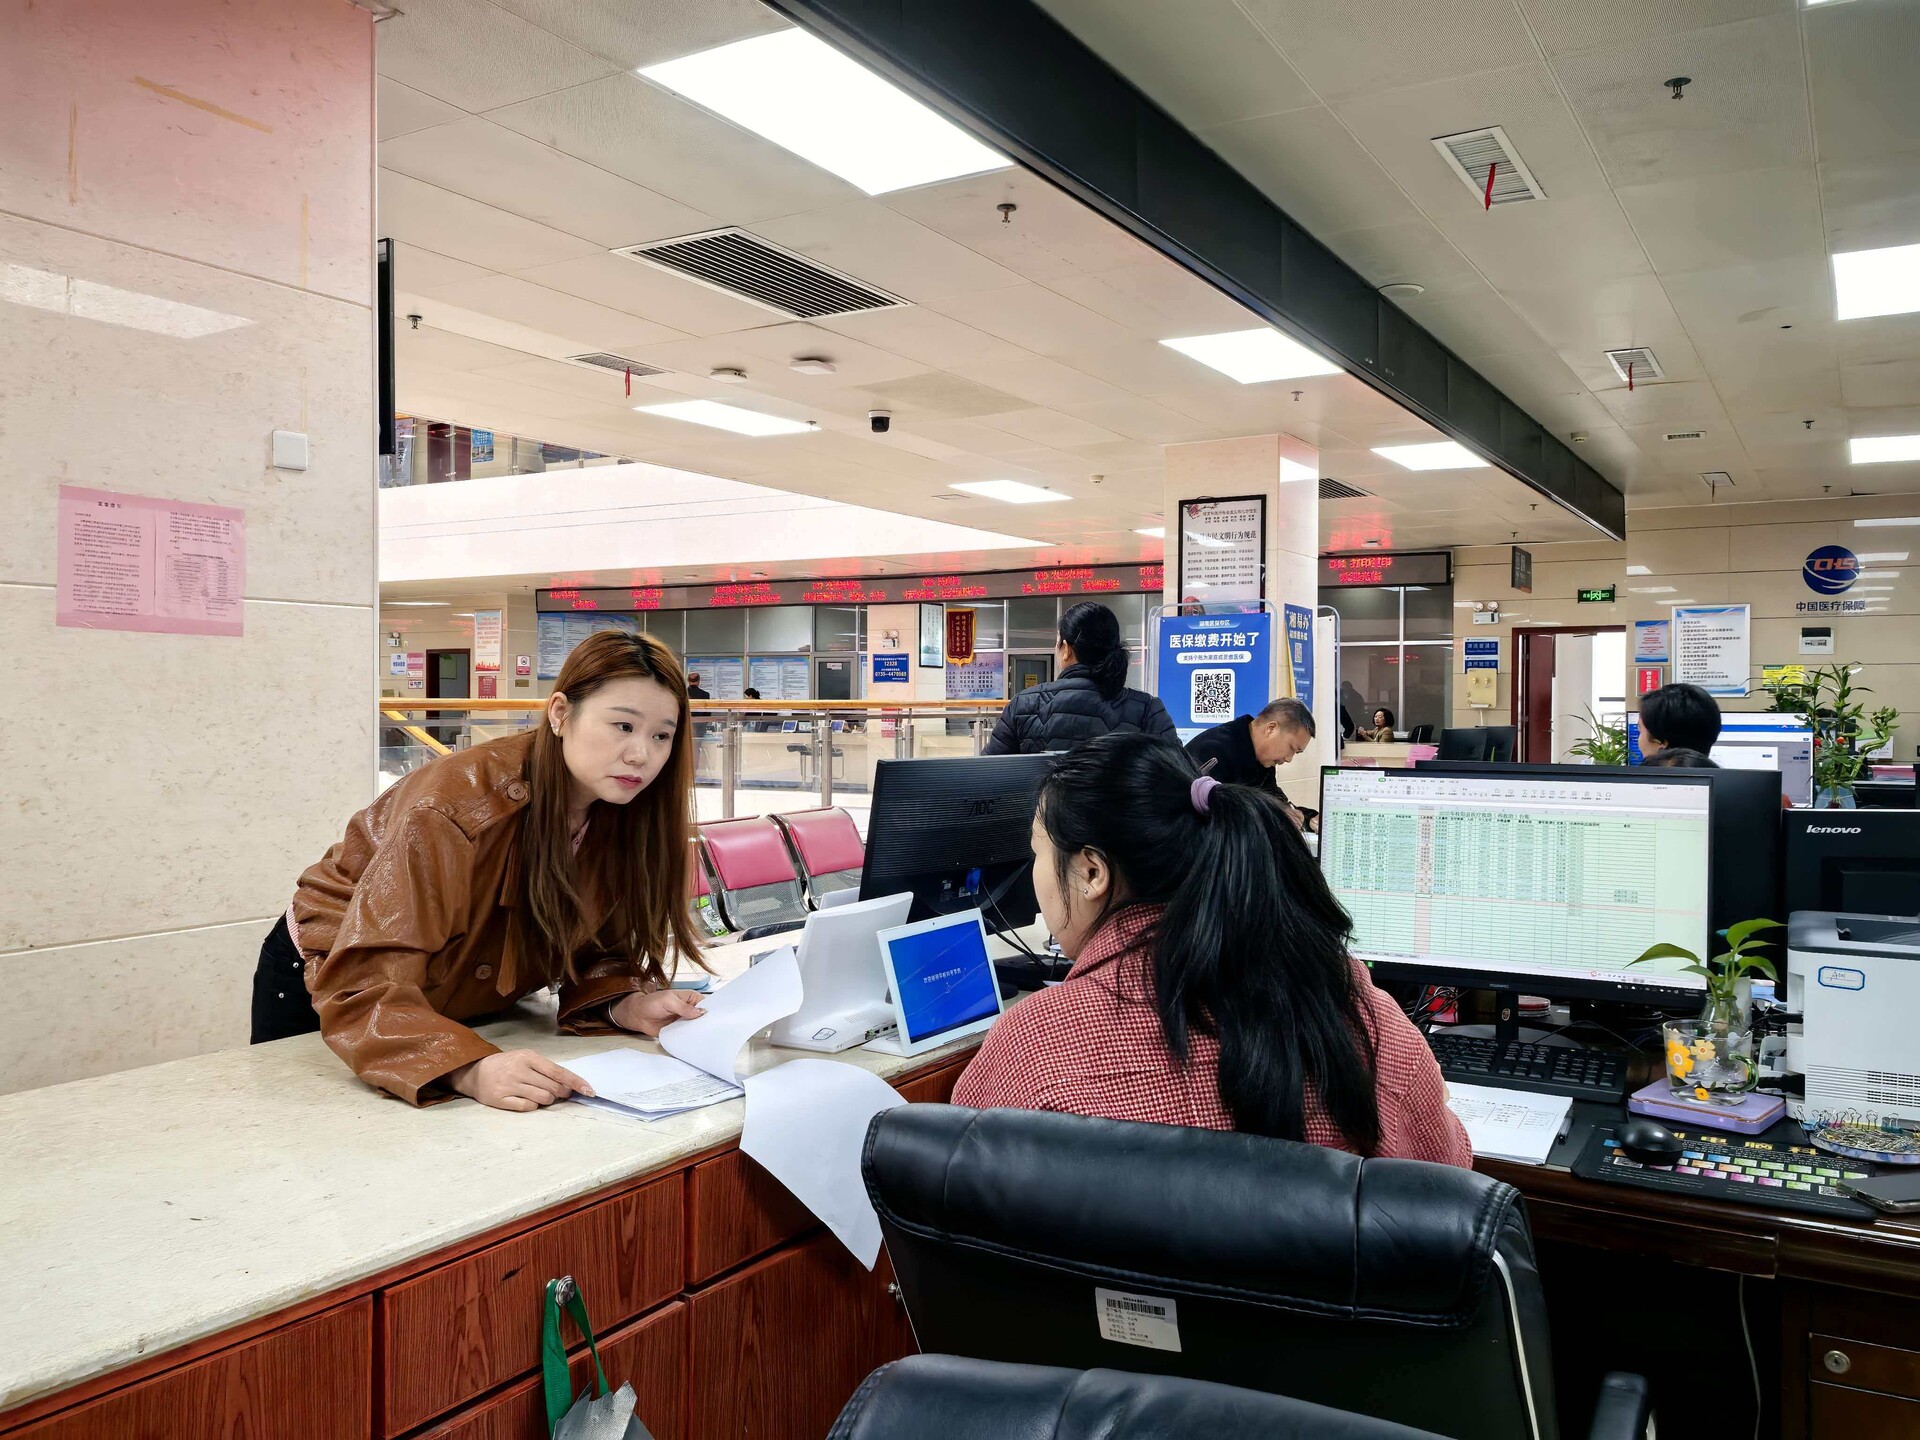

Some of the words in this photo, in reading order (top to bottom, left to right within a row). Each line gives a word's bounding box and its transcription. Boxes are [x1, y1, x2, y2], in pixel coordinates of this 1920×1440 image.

[1796, 600, 1866, 612] 中国医疗保障
[1169, 632, 1260, 648] 医保缴费开始了
[1806, 824, 1862, 834] lenovo
